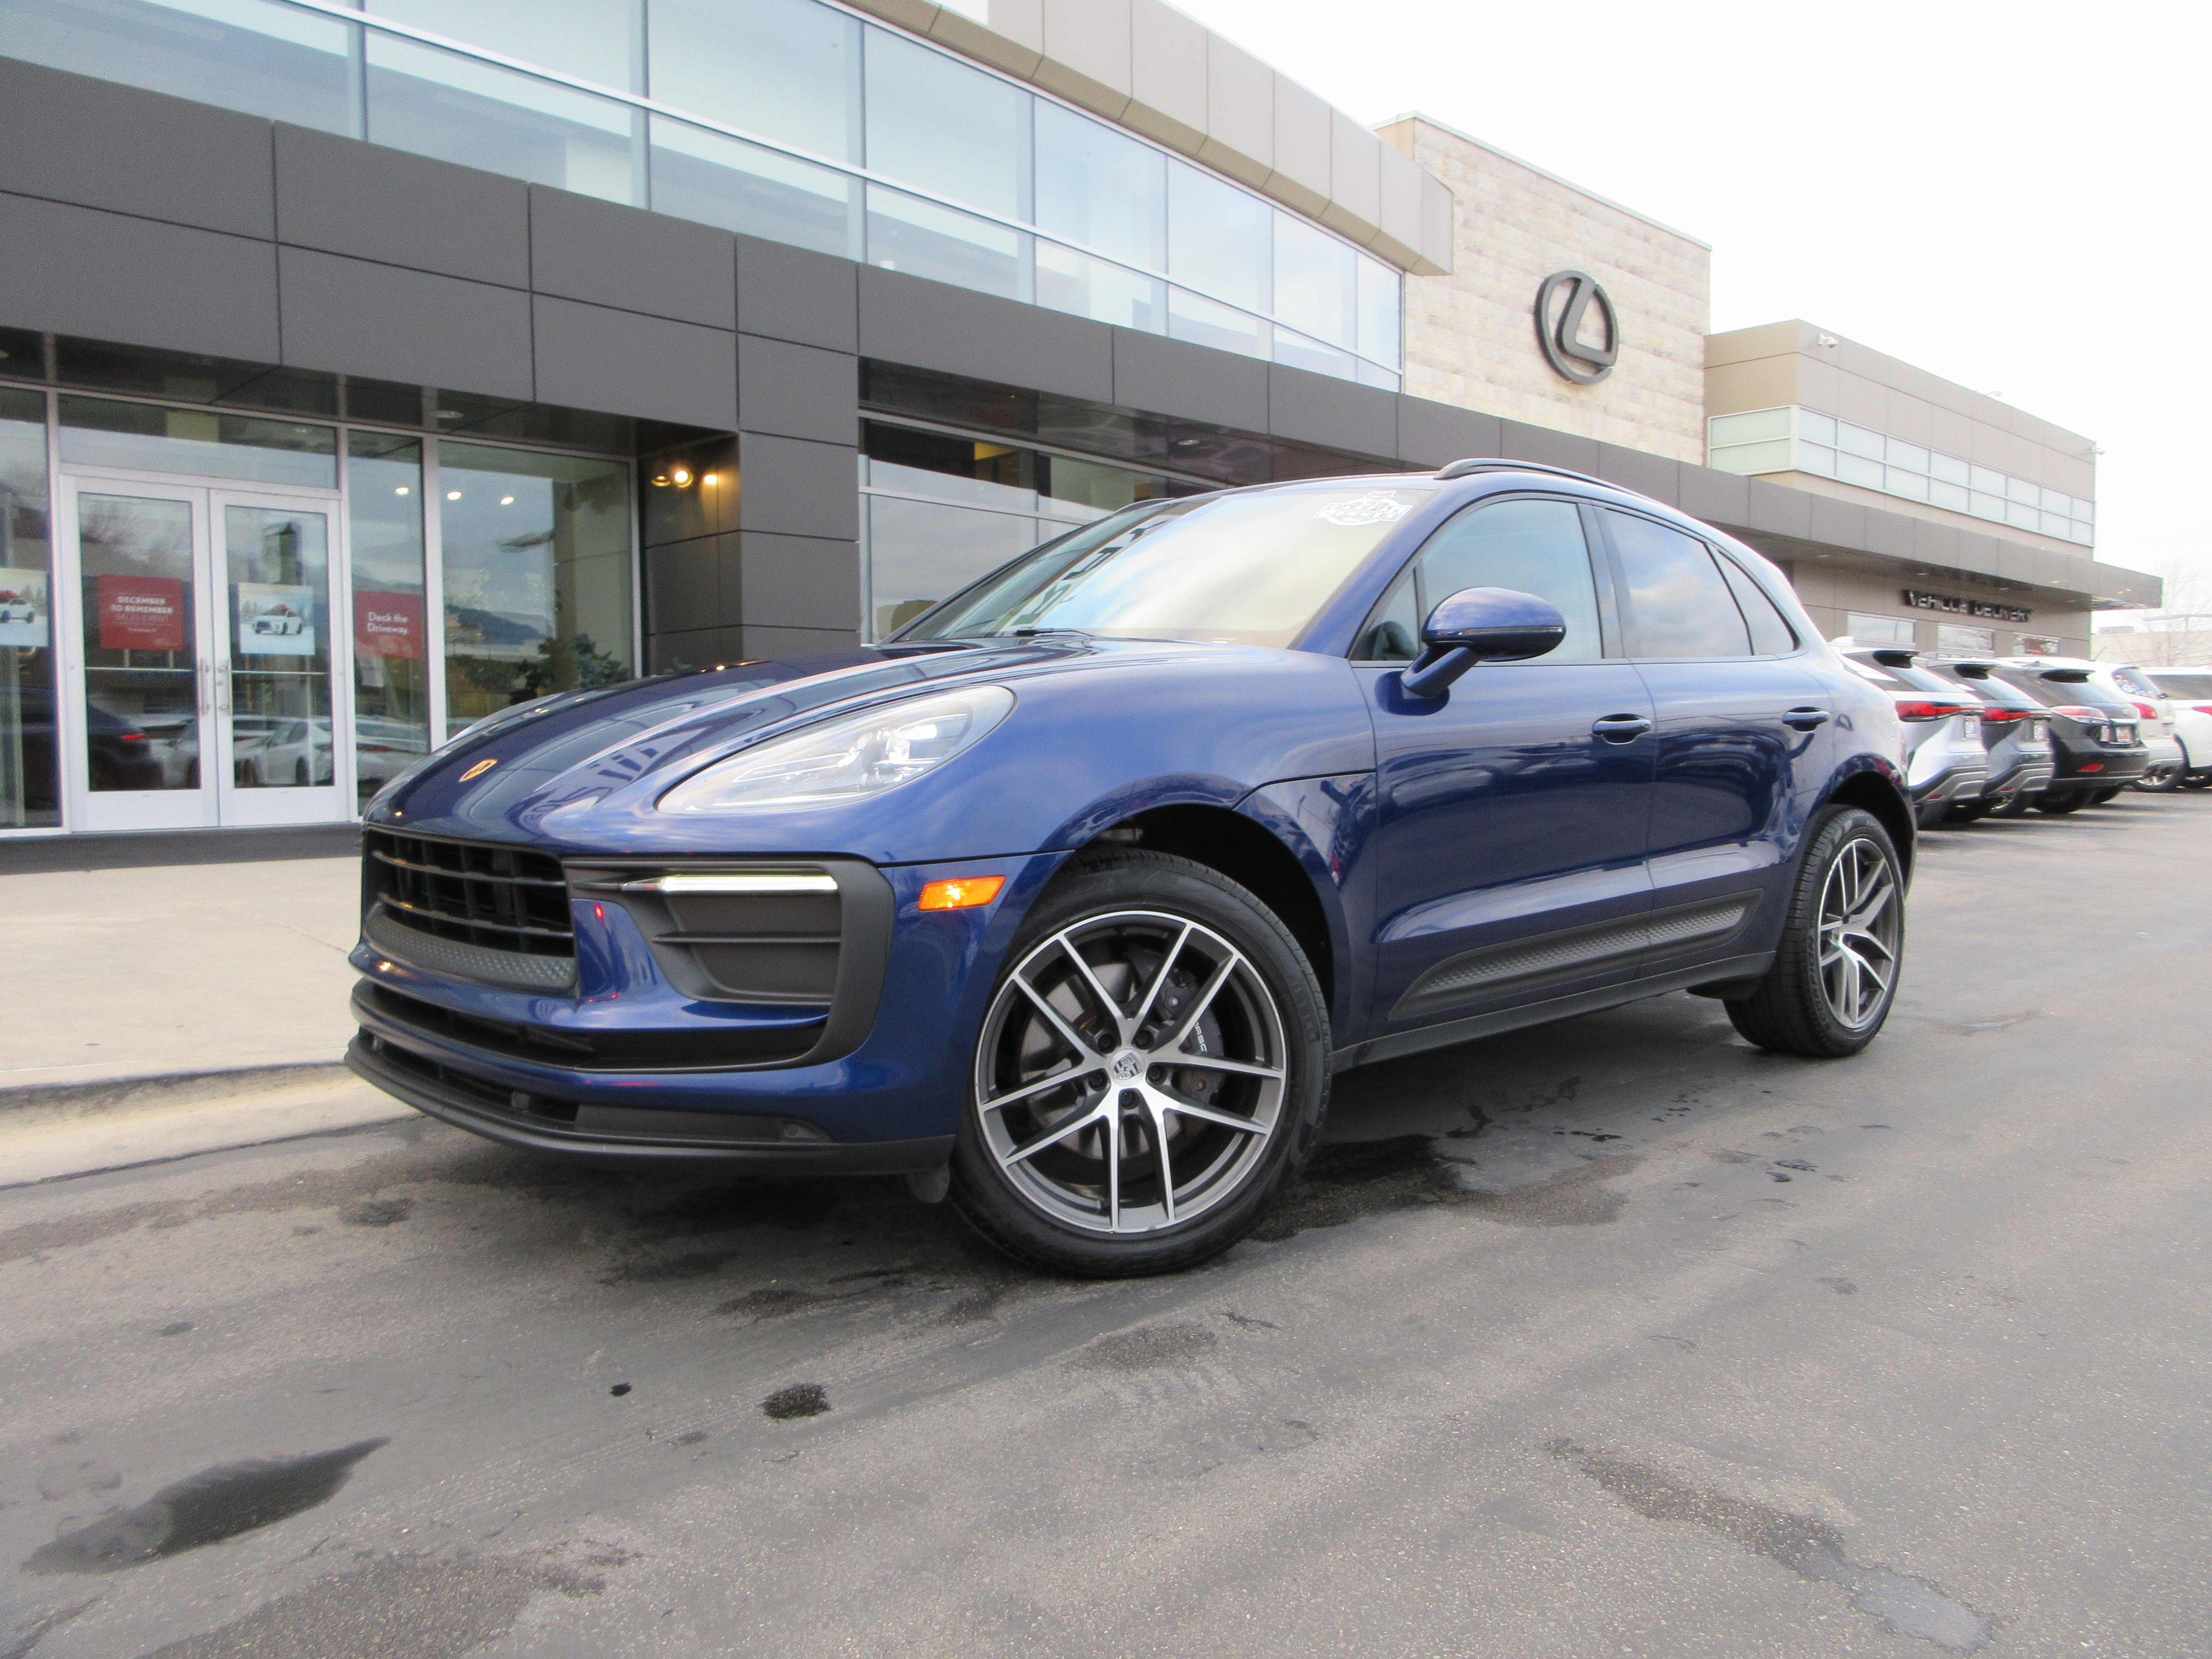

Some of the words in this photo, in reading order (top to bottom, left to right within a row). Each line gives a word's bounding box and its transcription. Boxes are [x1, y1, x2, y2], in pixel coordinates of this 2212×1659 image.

[1329, 504, 1403, 513] CARFAX
[1336, 511, 1399, 519] OWNER
[118, 596, 166, 605] DECEMBER
[125, 605, 173, 614] REMEMBER
[1903, 589, 1968, 614] VEHICLE
[1972, 600, 2032, 622] DELIVERY
[368, 611, 392, 622] Deck
[393, 613, 408, 623] the
